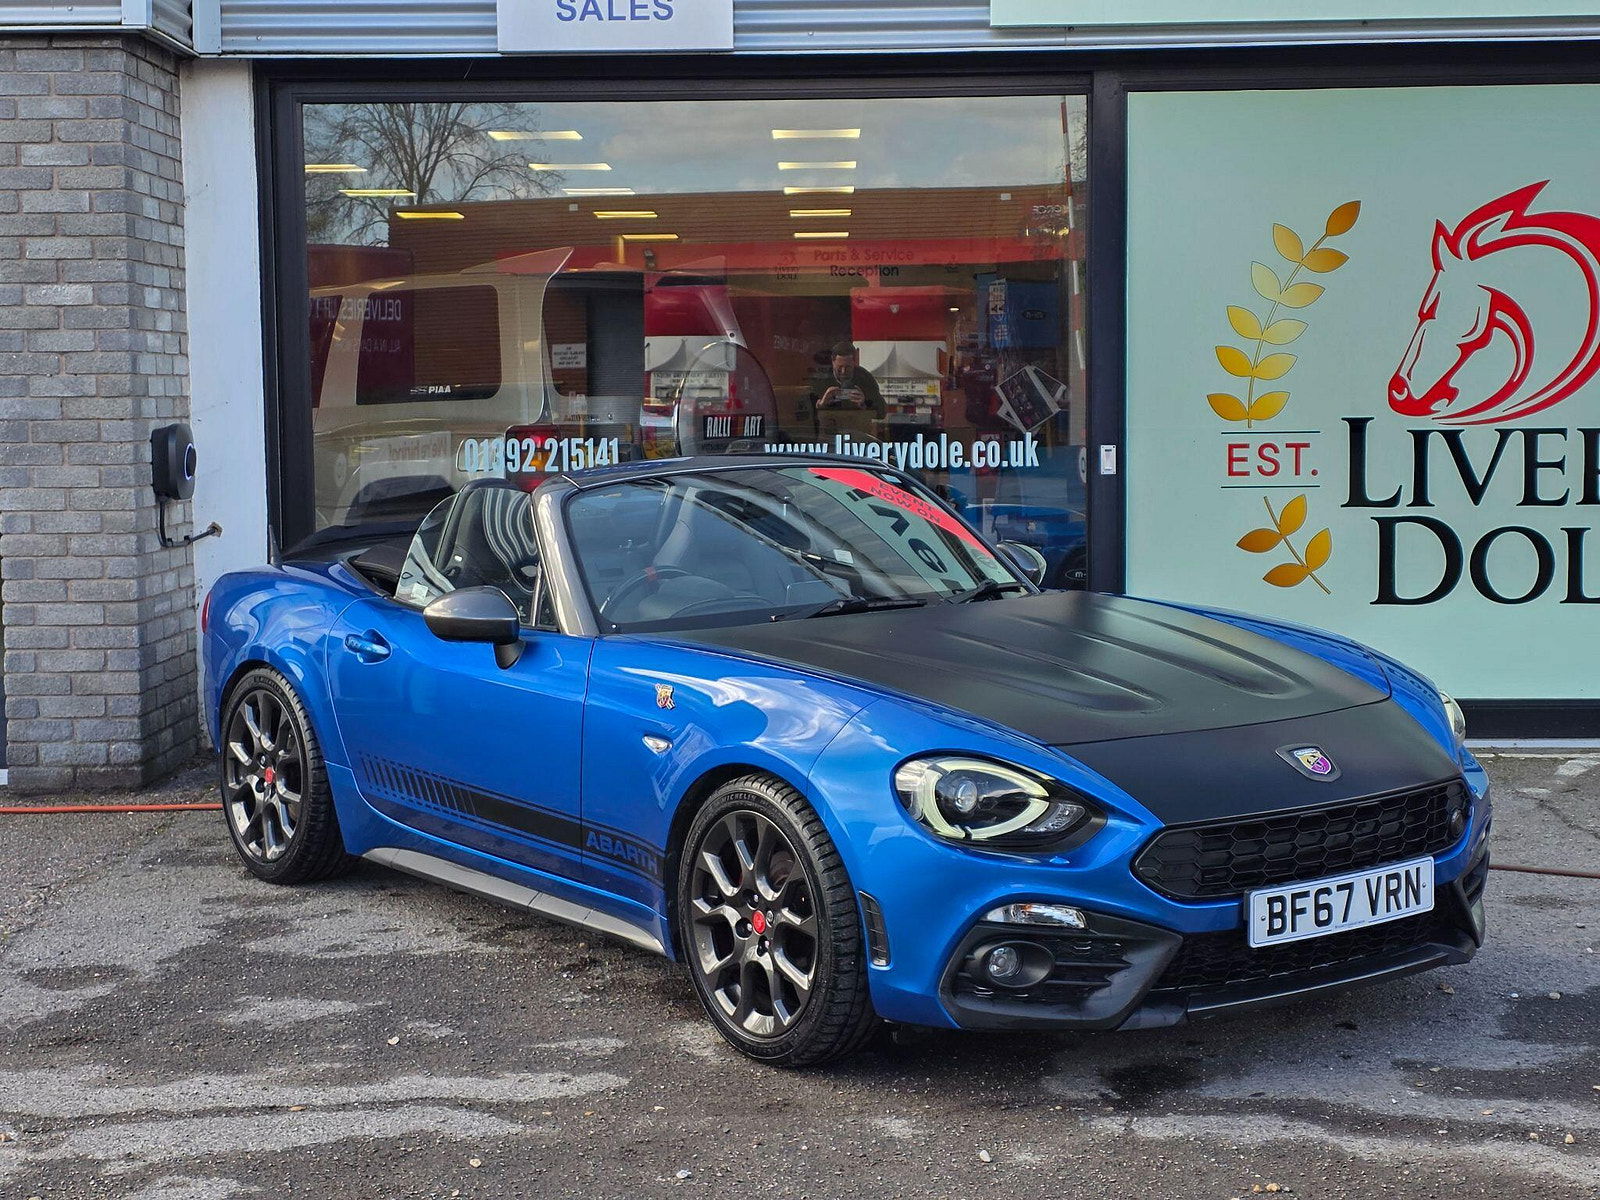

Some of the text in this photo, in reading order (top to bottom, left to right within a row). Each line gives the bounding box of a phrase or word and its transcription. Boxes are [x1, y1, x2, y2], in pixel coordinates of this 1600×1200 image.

[556, 0, 675, 22] SALES
[814, 249, 847, 261] Parts
[864, 248, 914, 261] Service
[830, 264, 899, 277] Reception
[428, 385, 451, 394] PIAA
[743, 415, 762, 436] ART
[464, 437, 536, 473] 01392
[544, 437, 619, 472] 215141
[764, 432, 1040, 472] liverydole.co.uk
[1227, 442, 1319, 477] EST.
[870, 486, 941, 523] NOW ON
[880, 483, 933, 511] EVENT
[585, 831, 659, 875] ABARTH
[1266, 867, 1422, 937] BF67 VRN
